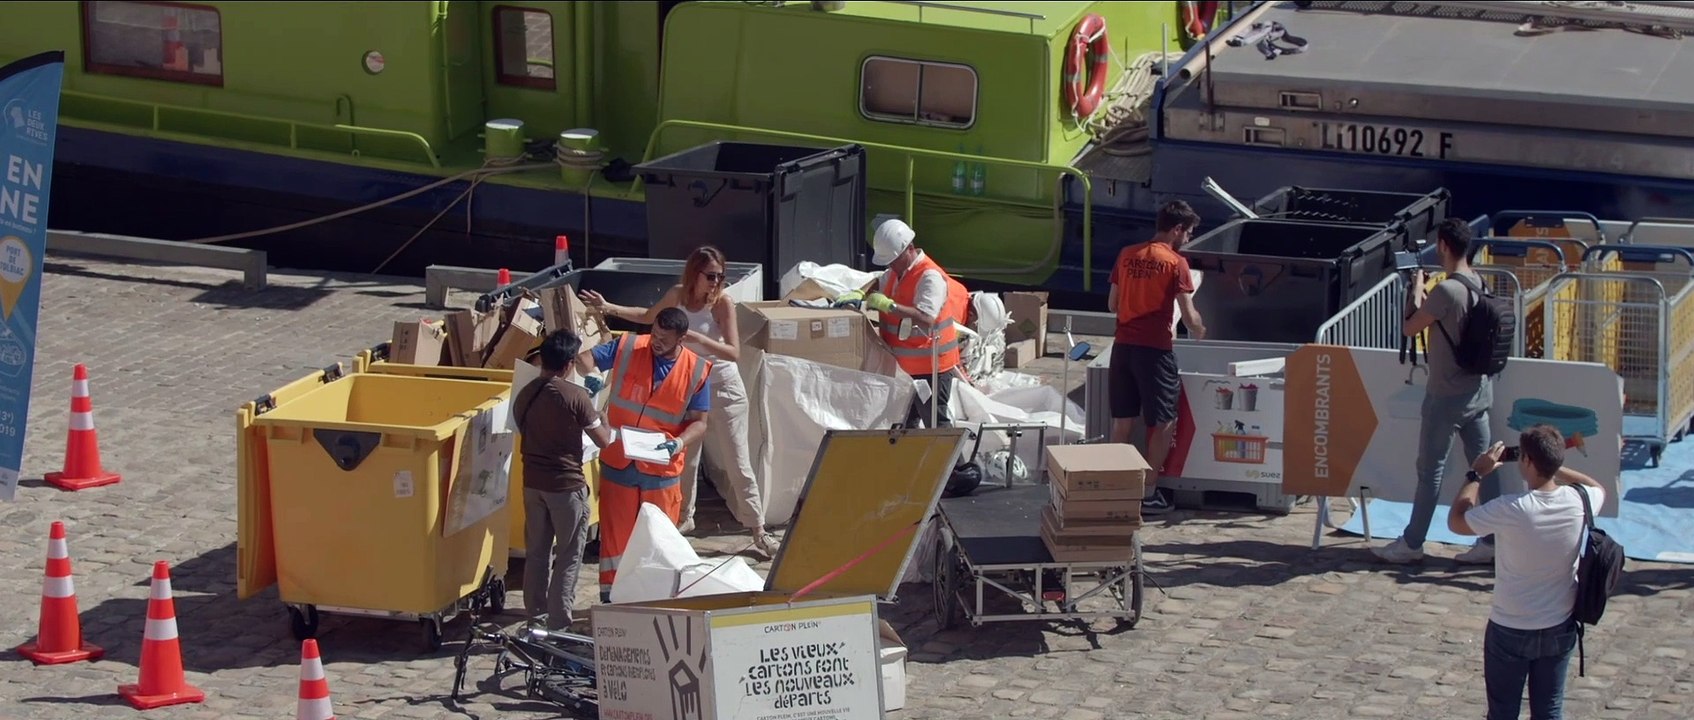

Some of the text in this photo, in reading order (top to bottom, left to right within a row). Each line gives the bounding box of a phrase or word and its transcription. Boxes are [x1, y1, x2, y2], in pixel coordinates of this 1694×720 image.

[28, 109, 42, 121] LES
[26, 127, 48, 141] RIVES
[1439, 131, 1453, 159] F
[7, 154, 43, 191] EN
[6, 245, 21, 257] PORT
[8, 255, 16, 265] DE
[1313, 353, 1332, 479] ENCOMBRANTS
[764, 622, 797, 634] CARTON
[760, 646, 789, 663] Les
[815, 657, 849, 673] font
[775, 672, 855, 693] nouveaux
